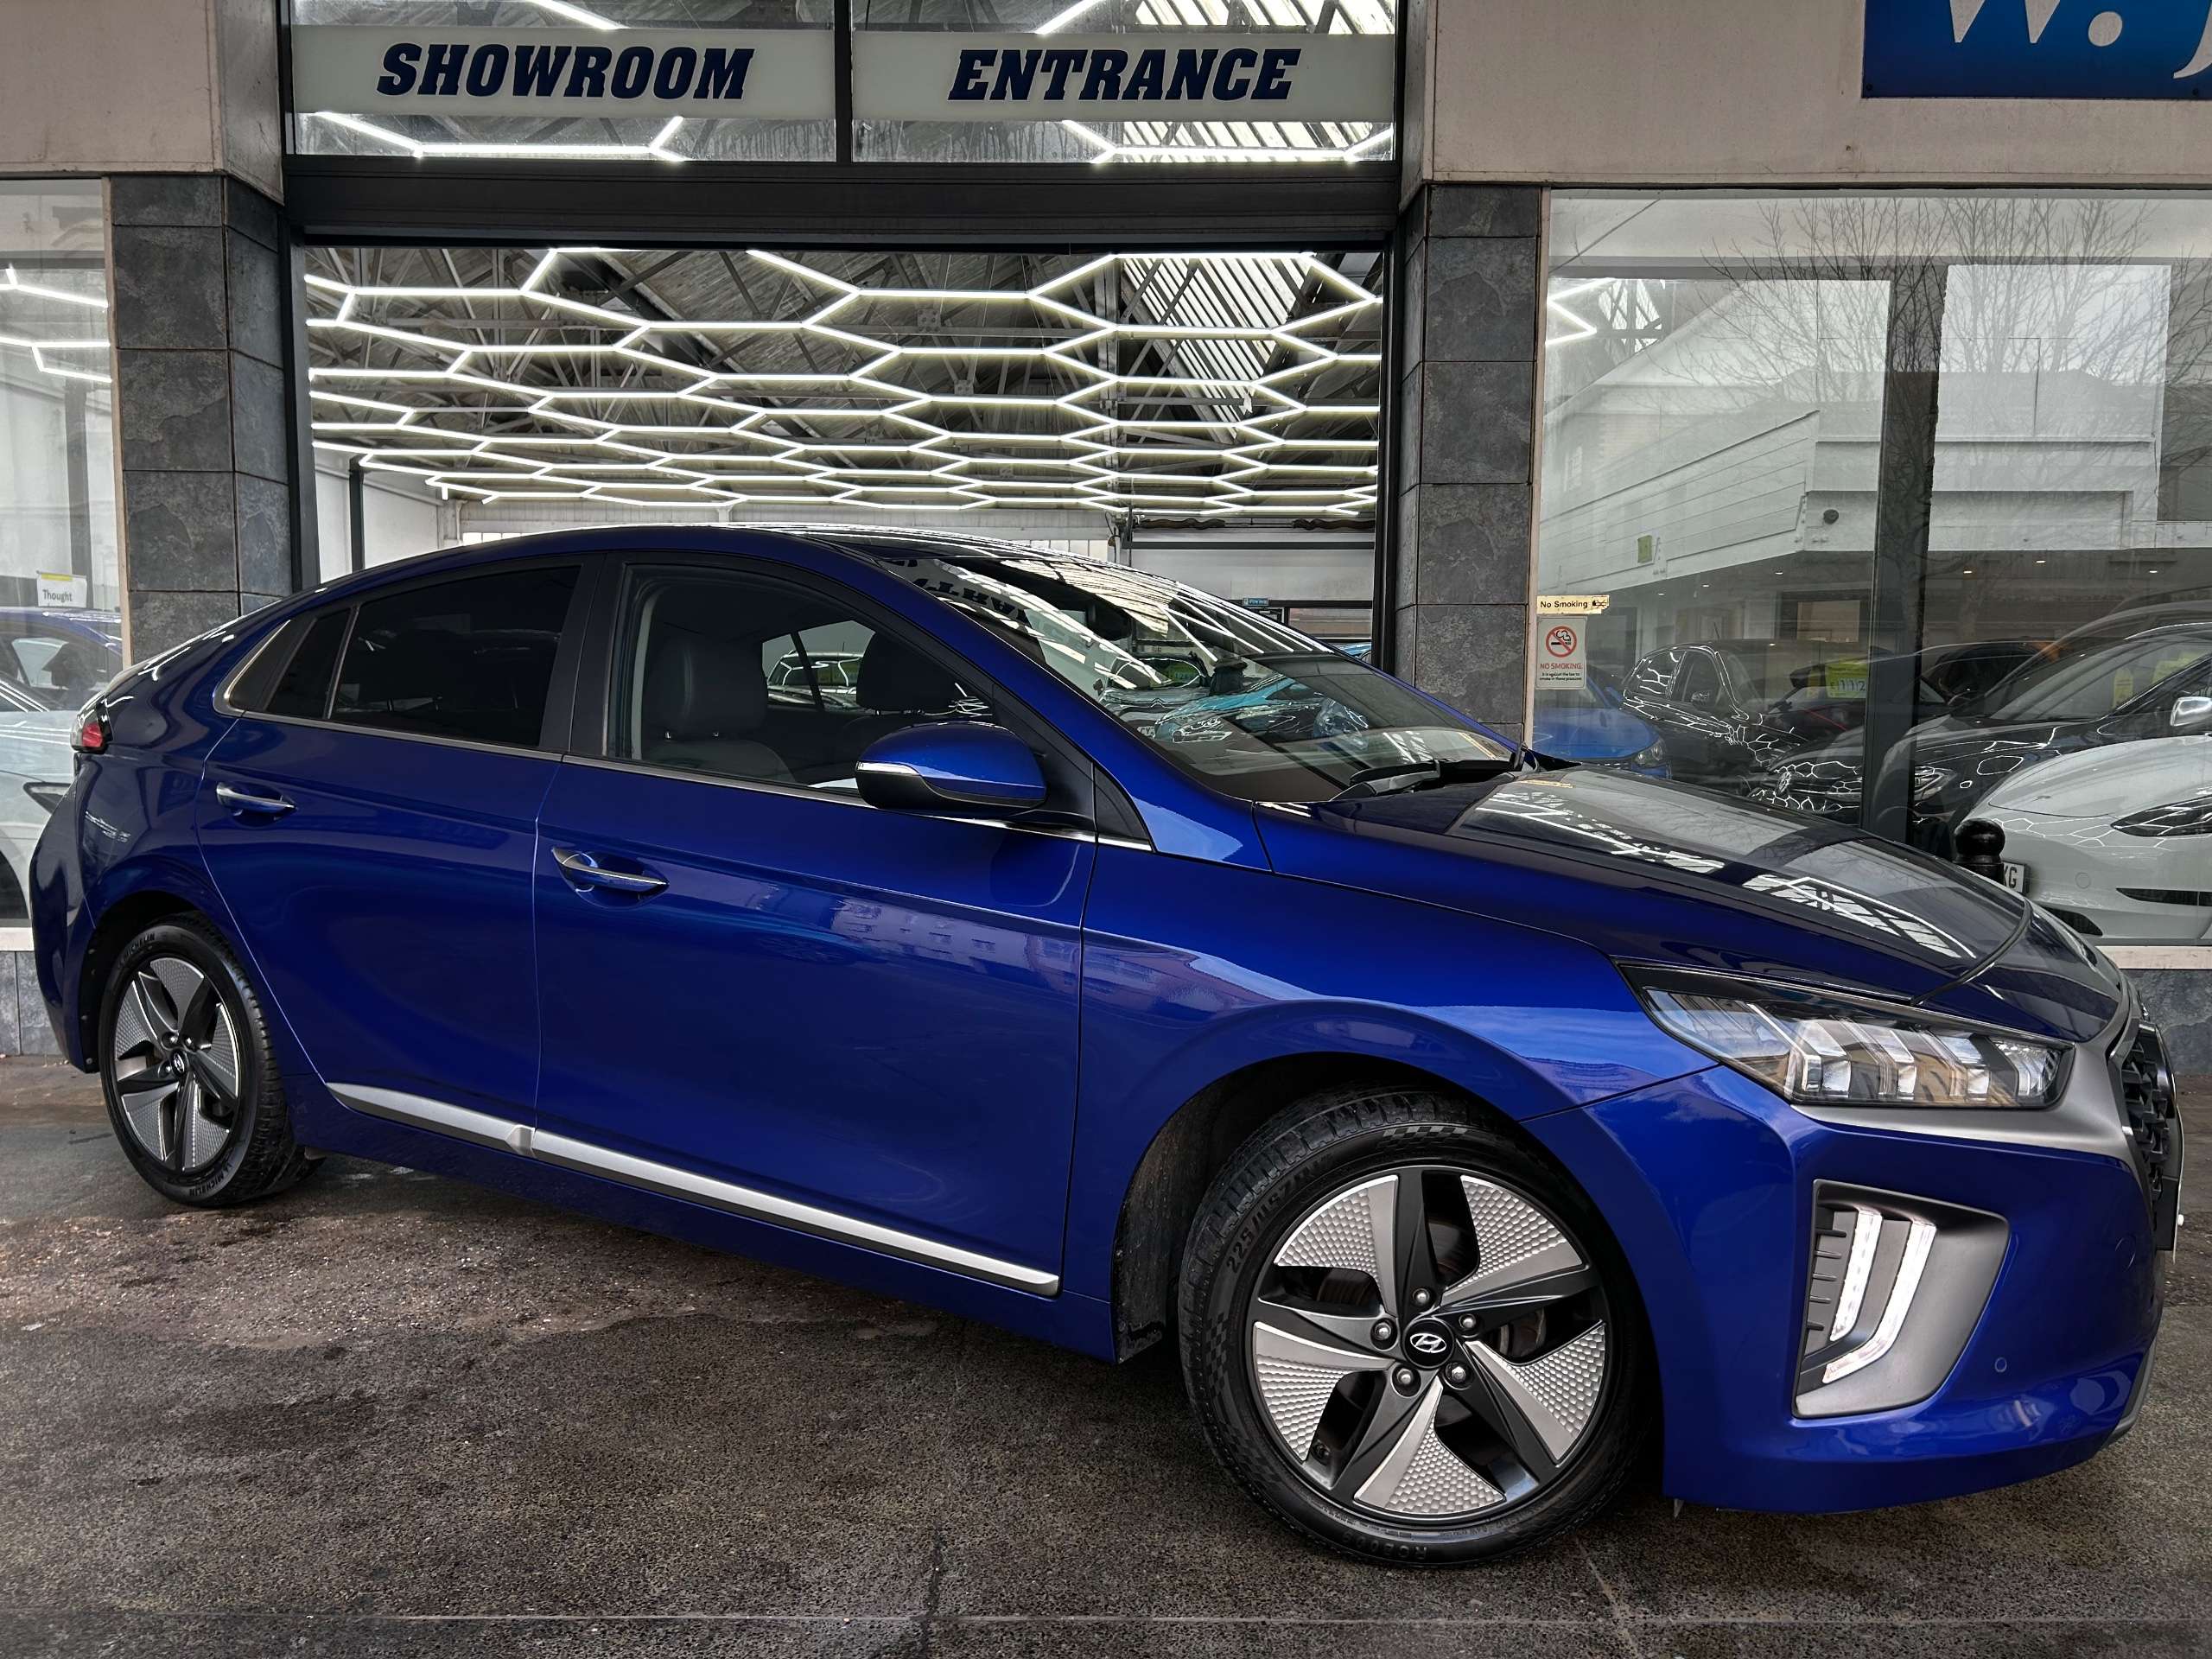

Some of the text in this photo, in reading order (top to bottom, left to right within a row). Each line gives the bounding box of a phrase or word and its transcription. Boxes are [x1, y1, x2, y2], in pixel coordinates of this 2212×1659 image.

[375, 42, 1302, 101] SHOWROOM ENTRANCE
[42, 589, 73, 602] Thought
[1554, 601, 1588, 609] Smoking
